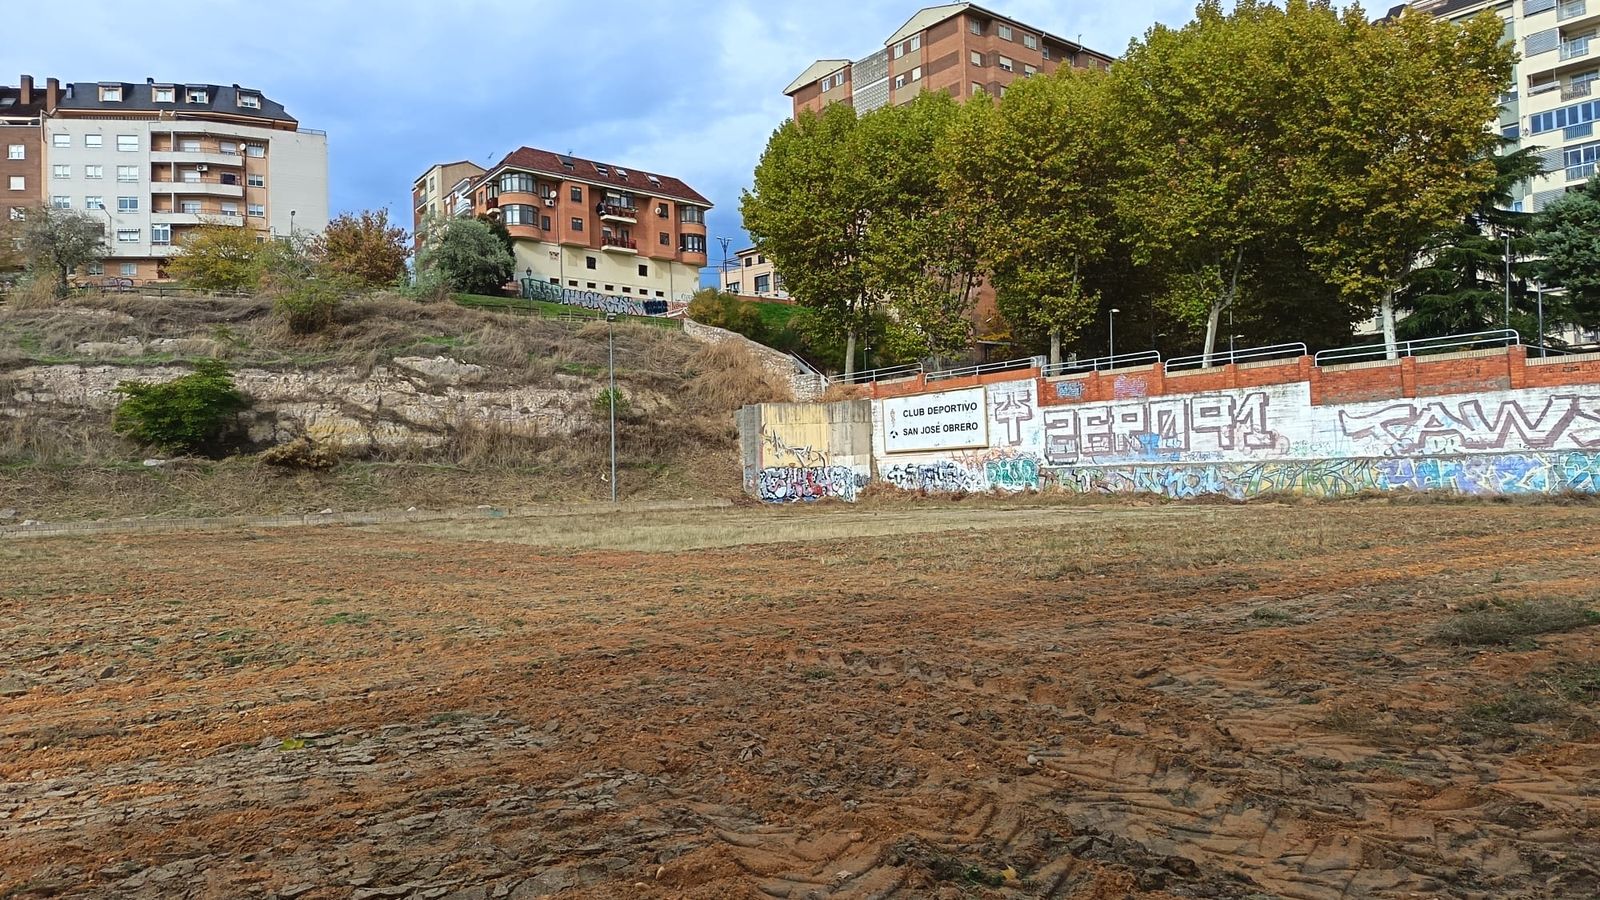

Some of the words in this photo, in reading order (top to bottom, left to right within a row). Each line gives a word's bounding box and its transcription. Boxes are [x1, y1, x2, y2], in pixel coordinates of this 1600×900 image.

[902, 408, 925, 418] CLUB
[927, 402, 978, 415] DEPORTIVO
[902, 427, 919, 436] SAN
[942, 422, 979, 433] OBRERO
